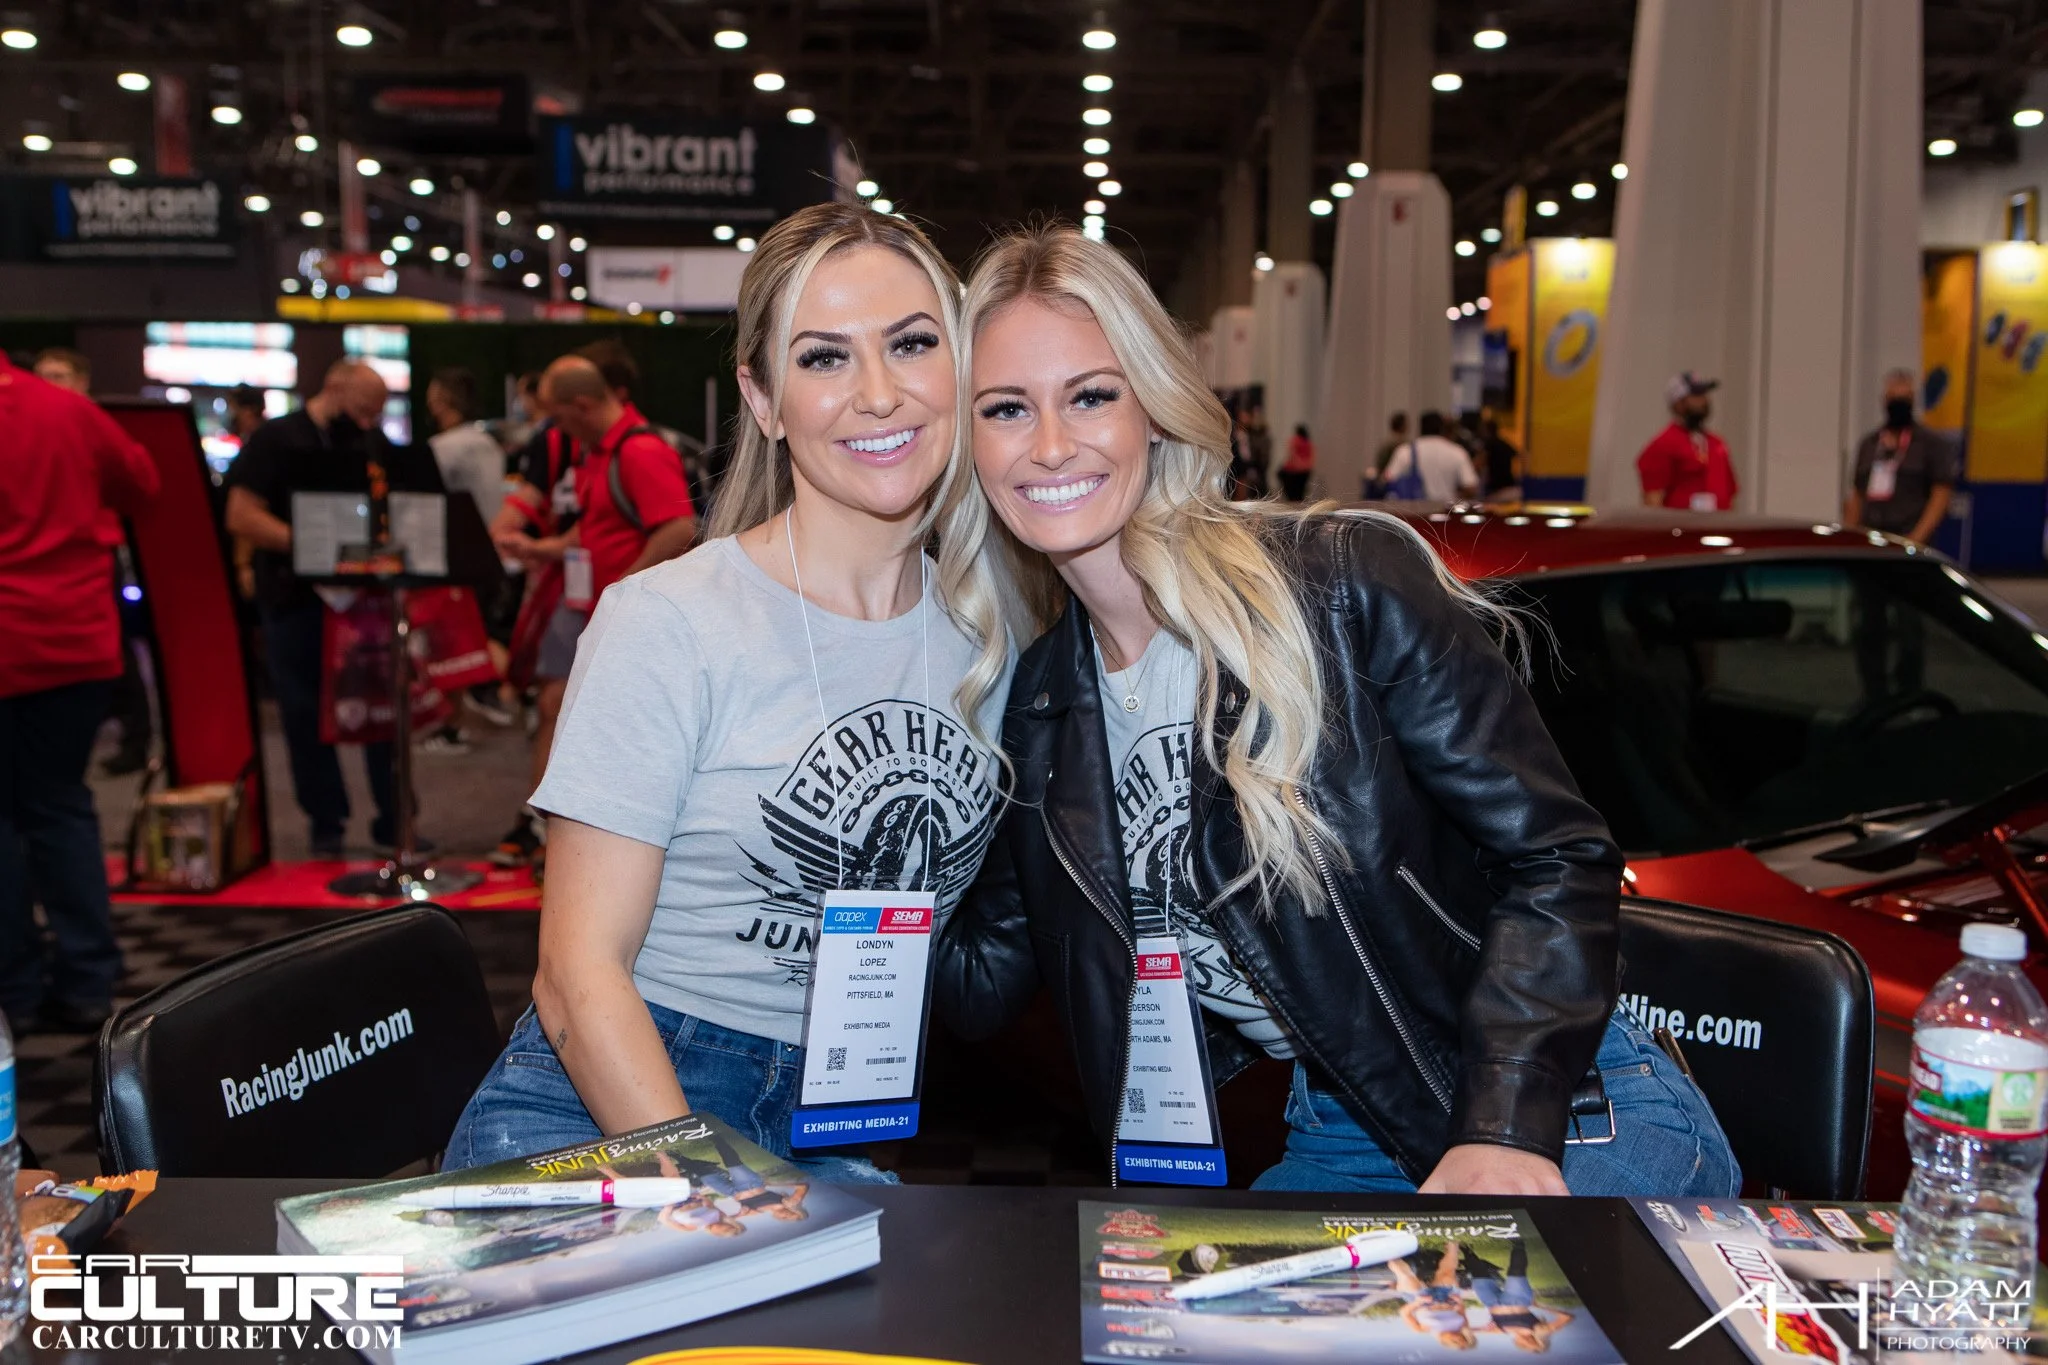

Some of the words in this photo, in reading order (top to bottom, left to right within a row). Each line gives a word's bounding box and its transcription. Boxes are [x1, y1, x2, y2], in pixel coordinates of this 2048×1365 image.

[574, 122, 757, 174] vibrant
[70, 180, 220, 220] vibrant
[789, 710, 896, 821] GEAR
[847, 764, 879, 800] BUILT
[886, 756, 901, 770] TO
[909, 756, 928, 768] GO
[936, 765, 964, 793] FAST
[834, 911, 868, 925] aapex
[891, 910, 924, 921] SEMA
[856, 940, 894, 949] LONDYN
[860, 958, 887, 967] LOPEZ
[1145, 957, 1172, 968] SEMA
[848, 973, 897, 981] RACINGJUNK.COM
[847, 991, 883, 1000] PITTSFIELD,
[884, 990, 894, 998] MA
[1131, 1003, 1161, 1012] DERSON
[843, 1022, 874, 1030] EXHIBITING
[874, 1021, 890, 1029] MEDIA
[1142, 1035, 1163, 1044] ADAMS,
[1163, 1035, 1172, 1043] MA
[220, 1007, 414, 1118] RacingJunk.com
[1132, 1065, 1158, 1073] EXHIBITING
[1157, 1065, 1173, 1073] MEDIA
[803, 1119, 863, 1134] EXHIBITING
[865, 1116, 909, 1129] MEDIA-21
[1124, 1157, 1174, 1170] EXHIBITING
[1175, 1160, 1216, 1172] MEDIA-21
[481, 1184, 531, 1198] Sharpie
